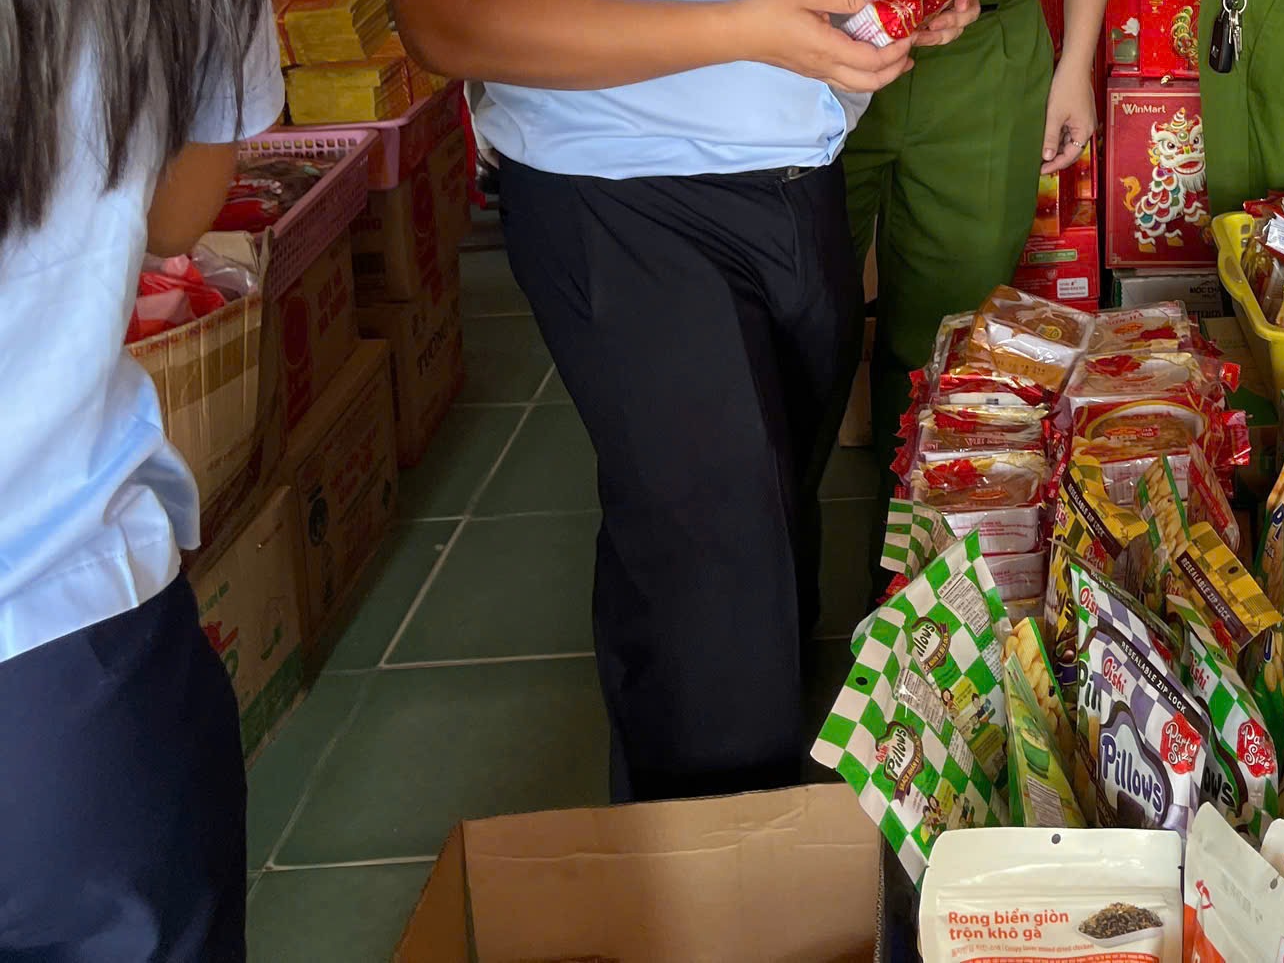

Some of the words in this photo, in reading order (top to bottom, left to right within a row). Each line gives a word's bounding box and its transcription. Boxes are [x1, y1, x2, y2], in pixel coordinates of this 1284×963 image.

[1122, 103, 1166, 115] WinMart
[1181, 556, 1209, 595] RESEALABLE
[1216, 602, 1231, 622] LOCK
[1102, 657, 1128, 695] Oishi
[1121, 641, 1157, 684] RESEALABLE
[1157, 680, 1169, 696] ZIP
[1168, 692, 1188, 715] LOCK
[888, 728, 908, 778] Pillows
[1165, 722, 1198, 755] Party
[1168, 742, 1193, 766] Size
[1101, 733, 1164, 813] Pillows
[1244, 745, 1271, 770] Size
[948, 911, 990, 927] Rong
[995, 908, 1030, 925] biển
[1034, 910, 1069, 927] giòn
[949, 926, 984, 943] trộn
[988, 925, 1018, 940] khô
[1023, 925, 1042, 941] gà
